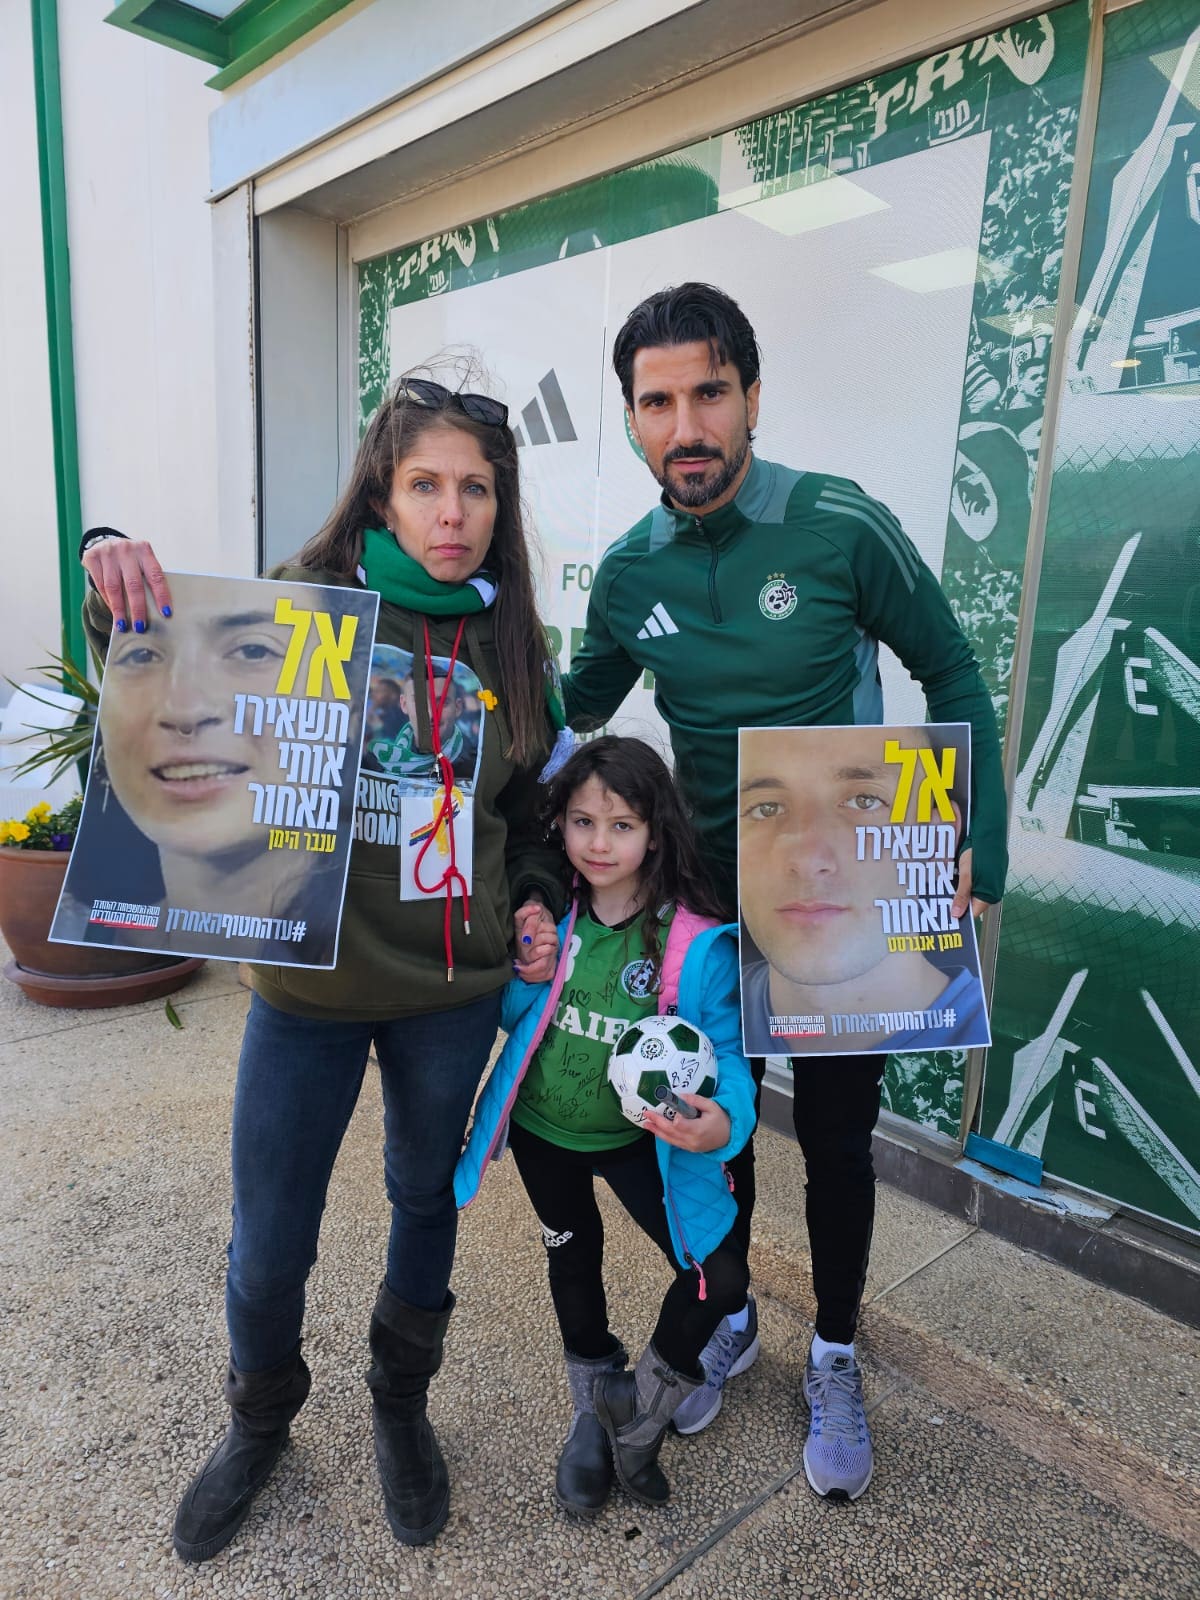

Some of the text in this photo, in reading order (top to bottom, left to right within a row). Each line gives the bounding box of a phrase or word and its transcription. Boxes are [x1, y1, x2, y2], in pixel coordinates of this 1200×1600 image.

[274, 598, 359, 700] אל
[233, 693, 350, 743] תשאירו
[278, 741, 346, 787] אותי
[884, 740, 957, 823] אל
[248, 782, 340, 831] מאחור
[356, 776, 400, 814] RING
[268, 828, 337, 853] ענבר הימן
[353, 810, 401, 846] HOM
[855, 825, 955, 861] תשאירו
[897, 861, 956, 896] אותי
[165, 907, 307, 943] #עדהחטוףהאחרון
[874, 898, 960, 934] מאחור
[887, 933, 963, 953] מתן אנגרסט
[550, 1001, 630, 1045] AIF
[831, 1008, 957, 1037] #עדהחטוףהאחרון
